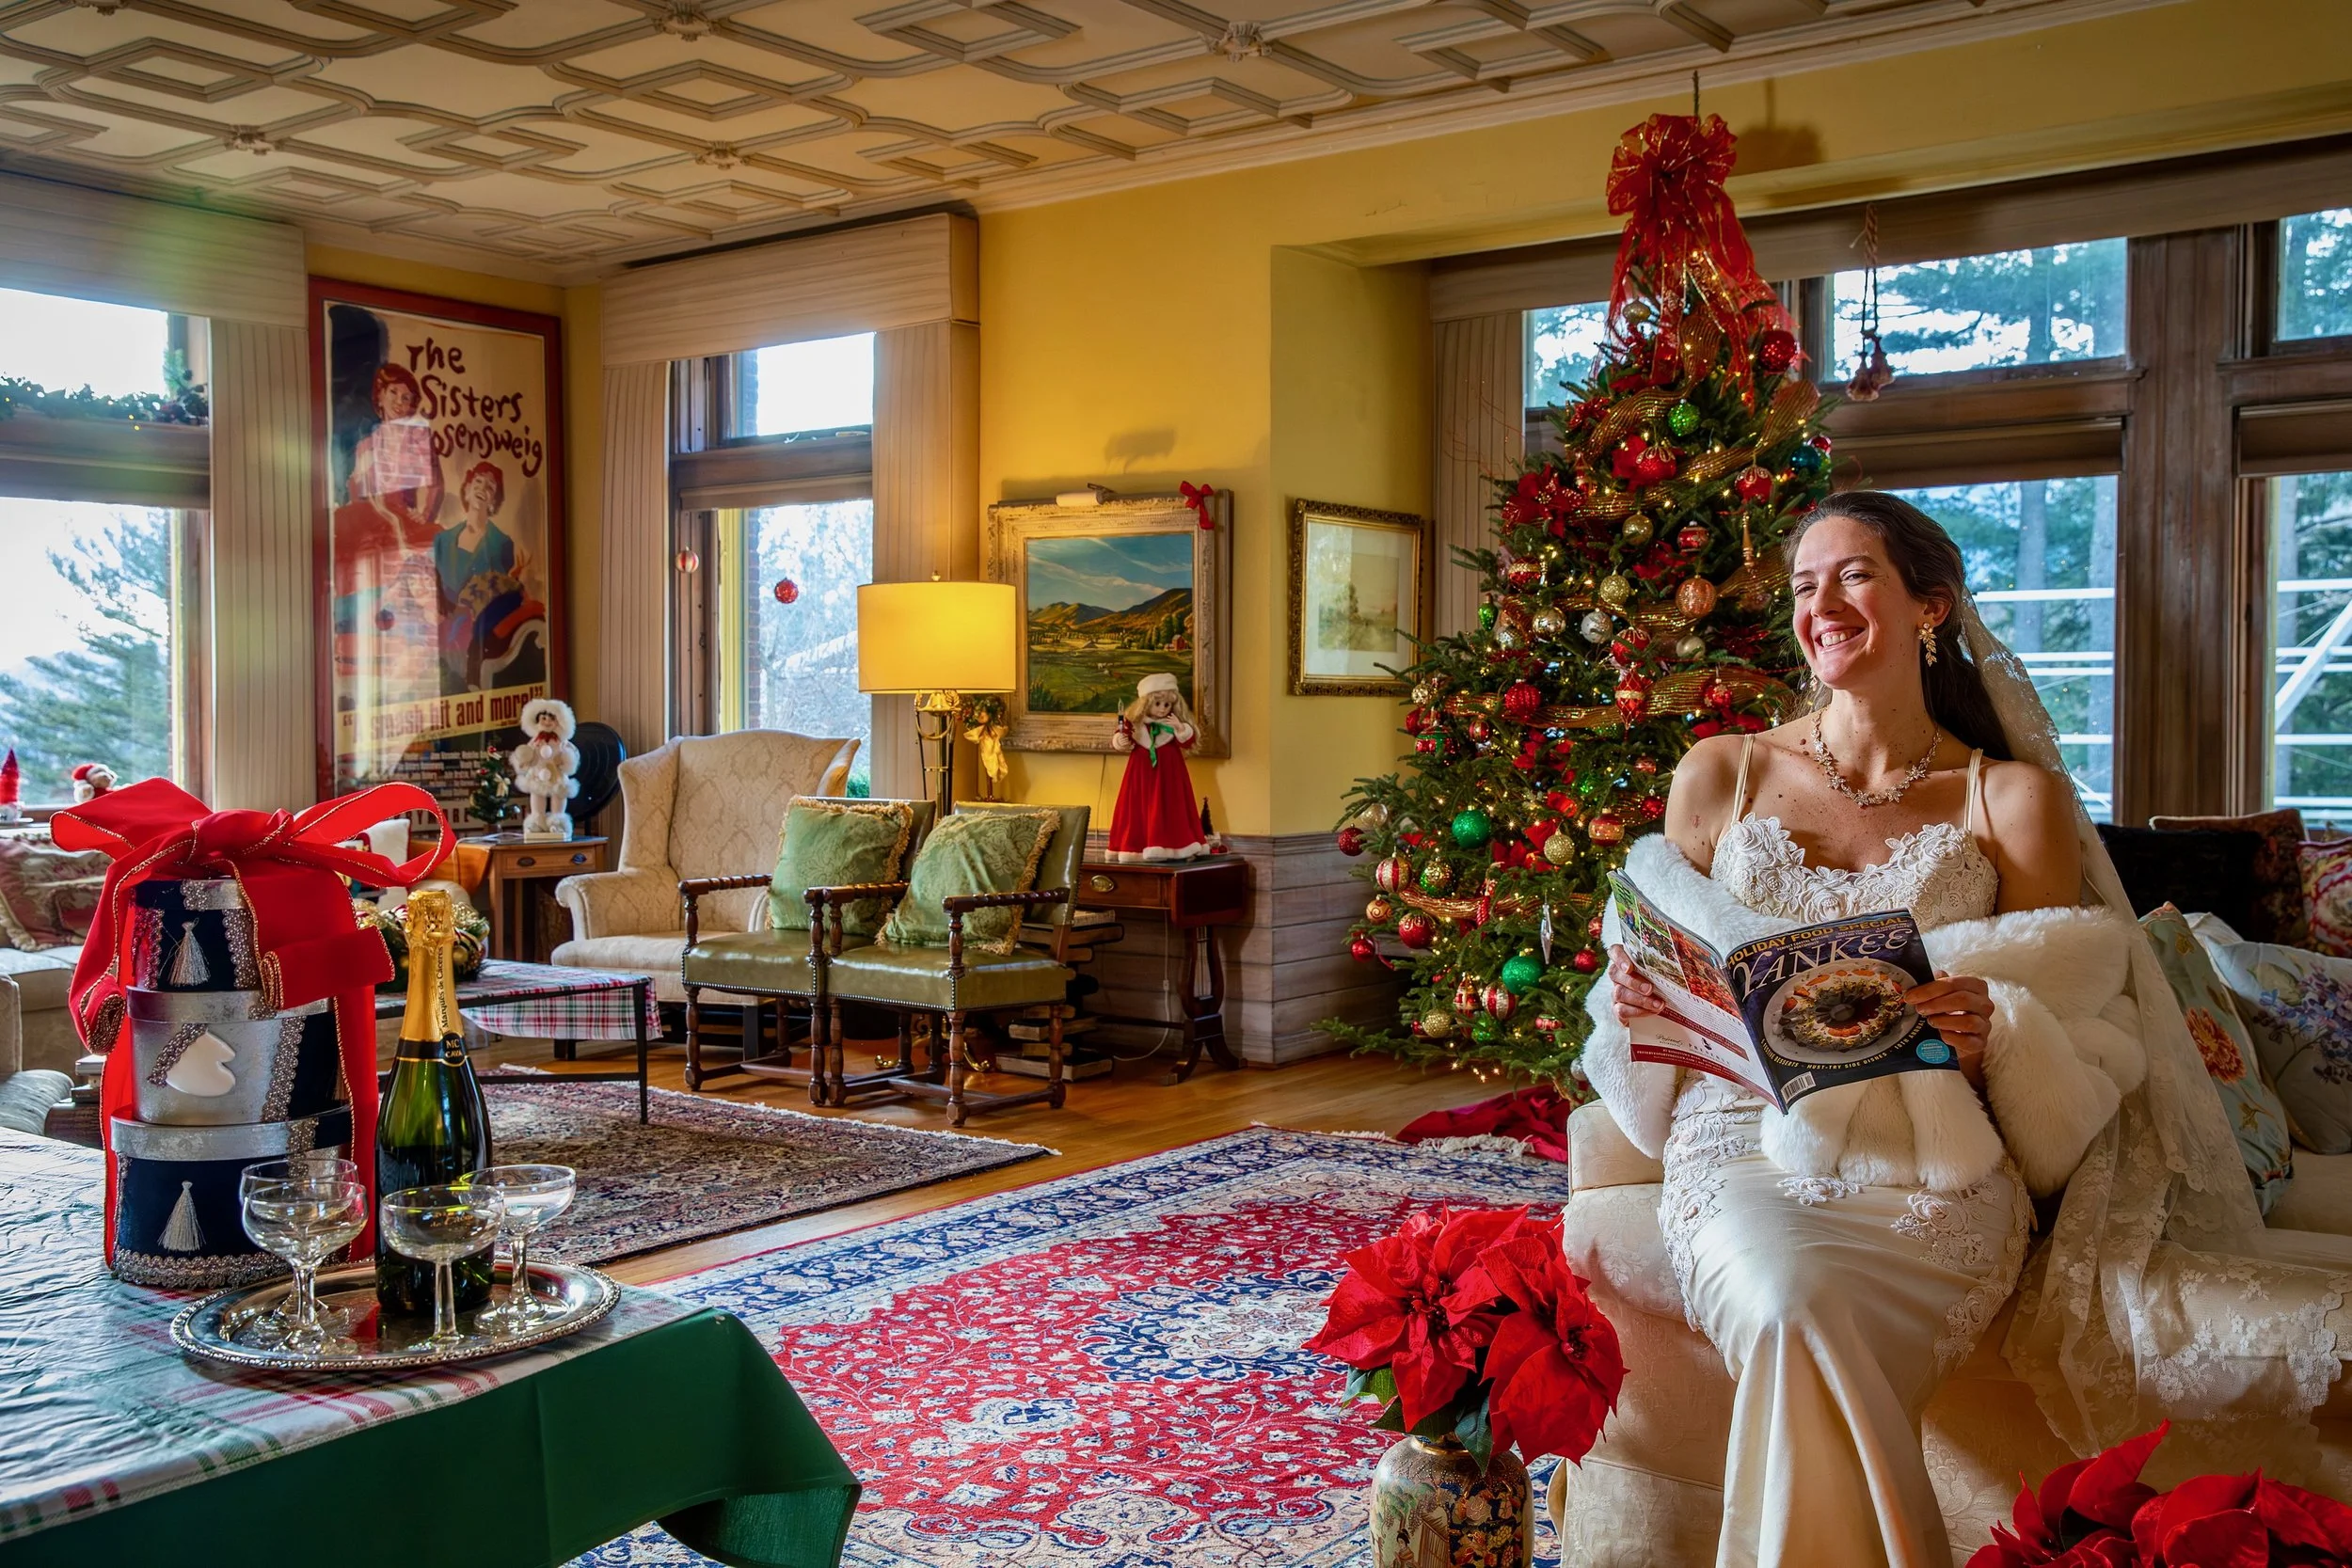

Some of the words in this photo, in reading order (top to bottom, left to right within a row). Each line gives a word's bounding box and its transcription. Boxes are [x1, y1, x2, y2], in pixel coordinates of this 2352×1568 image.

[405, 337, 467, 374] The
[420, 374, 524, 423] Sisters
[430, 422, 544, 478] osensweig
[430, 699, 452, 731] hit
[455, 694, 485, 727] and
[1726, 936, 1787, 970] HOLIDAY
[1791, 927, 1835, 942] FOOD
[1837, 917, 1908, 931] SPECIAL
[1732, 928, 1914, 1003] YANKEE
[437, 981, 444, 990] de
[438, 990, 449, 1028] Marqués
[446, 1038, 460, 1049] MC
[1773, 1055, 1800, 1068] DESSERTS
[1863, 1052, 1887, 1065] DISHES
